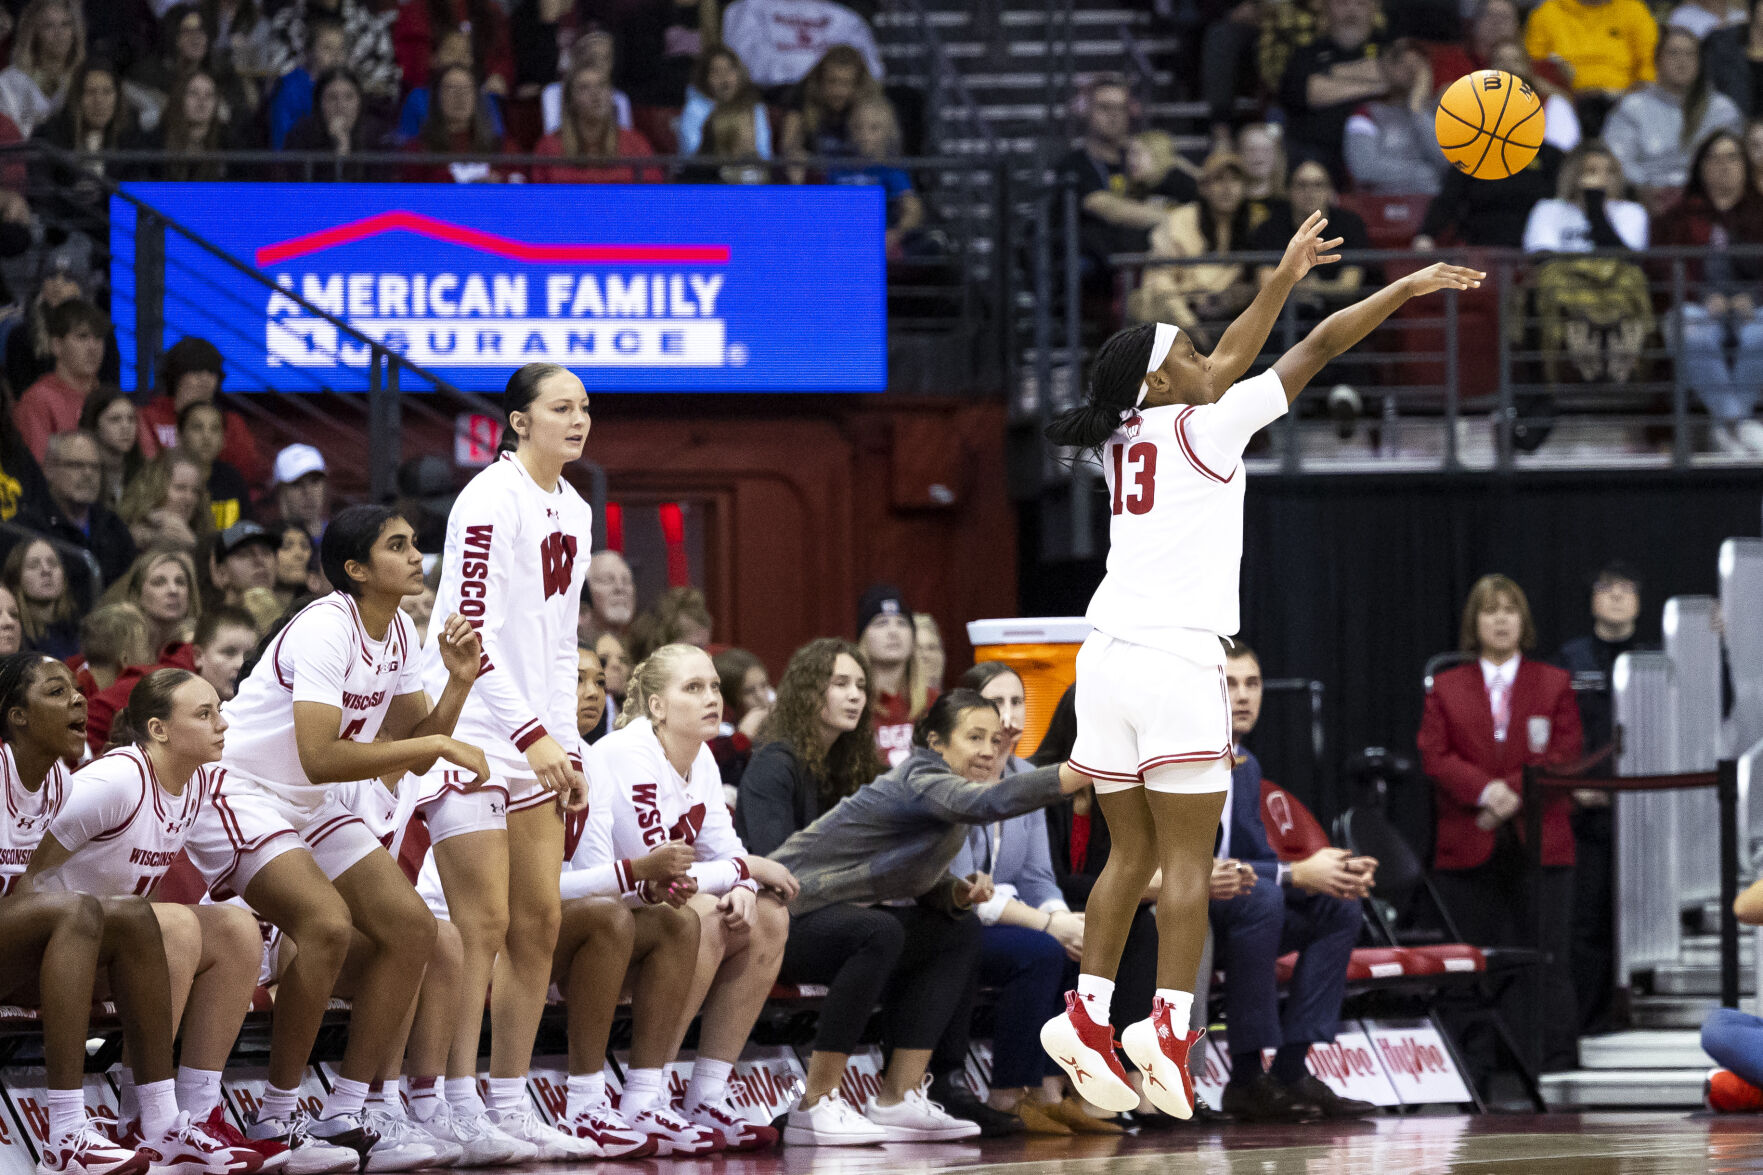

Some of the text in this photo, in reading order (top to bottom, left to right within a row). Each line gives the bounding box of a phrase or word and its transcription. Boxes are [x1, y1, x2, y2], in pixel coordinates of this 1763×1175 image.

[267, 272, 725, 318] AMERICAN FAMILY
[1112, 441, 1158, 516] 13
